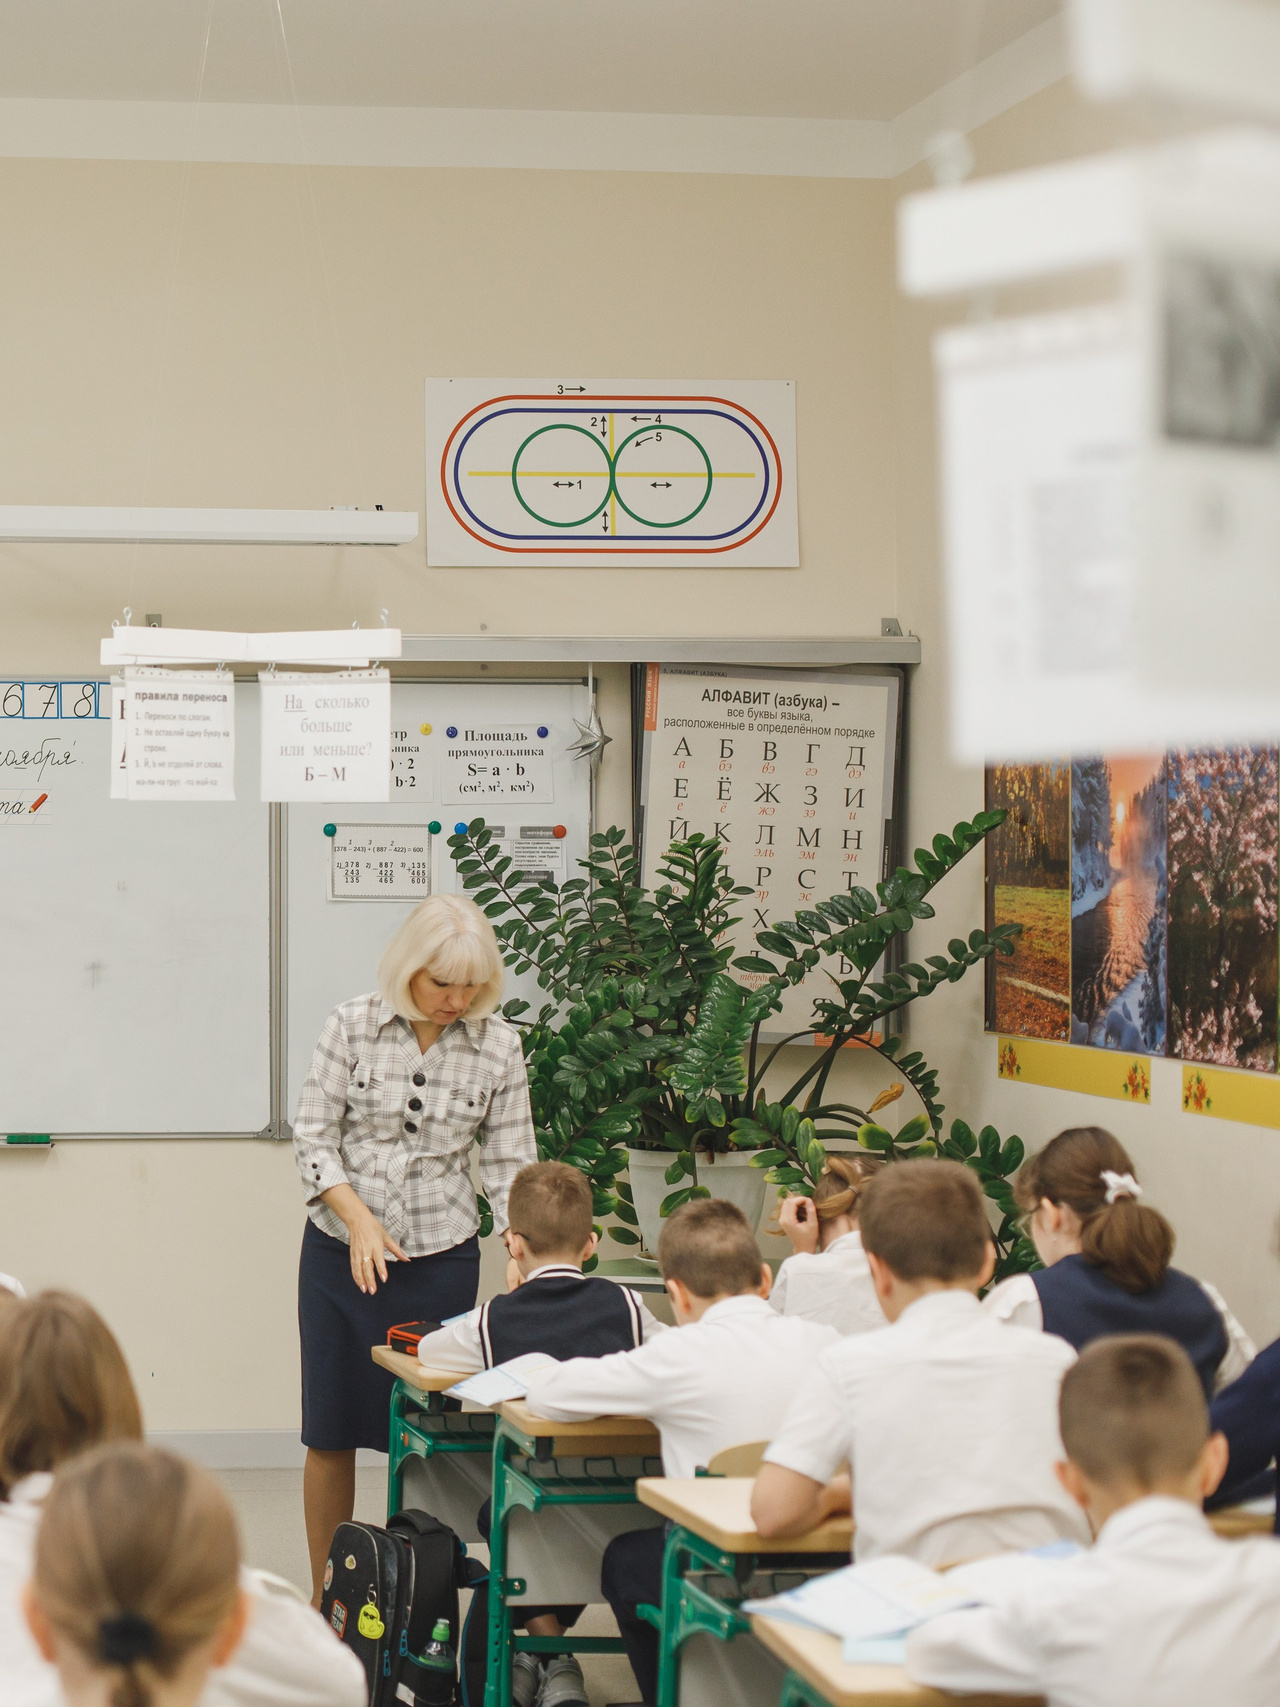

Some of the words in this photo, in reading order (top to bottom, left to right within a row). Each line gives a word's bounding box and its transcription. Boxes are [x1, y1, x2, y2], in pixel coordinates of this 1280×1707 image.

[557, 385, 563, 394] 3
[591, 417, 597, 427] 2
[655, 414, 662, 424] 4
[655, 432, 662, 442] 5
[577, 480, 582, 490] 1
[700, 670, 728, 678] (АЗБУКА)
[2, 683, 24, 717] 6
[38, 683, 58, 718] 7
[73, 683, 96, 717] 8
[135, 692, 179, 703] правила
[182, 693, 227, 703] переноса
[284, 694, 303, 709] На
[314, 697, 370, 709] сколько
[701, 688, 771, 706] АЛФАВИТ
[773, 693, 828, 712] (азбука)
[727, 707, 745, 718] все
[747, 707, 778, 722] буквы
[780, 710, 813, 723] языка,
[300, 718, 353, 733] больше
[664, 717, 746, 732] расположенные
[748, 722, 754, 731] в
[756, 722, 832, 737] определённом
[834, 726, 875, 739] порядке
[464, 730, 528, 742] Площадь
[280, 745, 305, 756] или
[313, 742, 372, 756] меньше?
[448, 748, 544, 759] прямоугольника
[673, 736, 692, 757] А
[719, 738, 734, 759] Б
[762, 741, 778, 761] В
[805, 743, 821, 764] Г
[845, 746, 866, 771] Д
[304, 767, 314, 782] Б
[332, 767, 346, 782] М
[492, 765, 500, 776] a
[516, 763, 525, 776] b
[673, 778, 689, 799] Е
[717, 776, 732, 801] Ё
[754, 782, 781, 804] Ж
[803, 785, 818, 806] З
[844, 787, 865, 809] И
[713, 821, 732, 844] К
[755, 824, 776, 846] Л
[796, 826, 822, 848] М
[841, 829, 864, 850] Н
[754, 866, 772, 887] Р
[797, 869, 816, 890] С
[752, 908, 770, 928] Х
[839, 955, 854, 975] Ь
